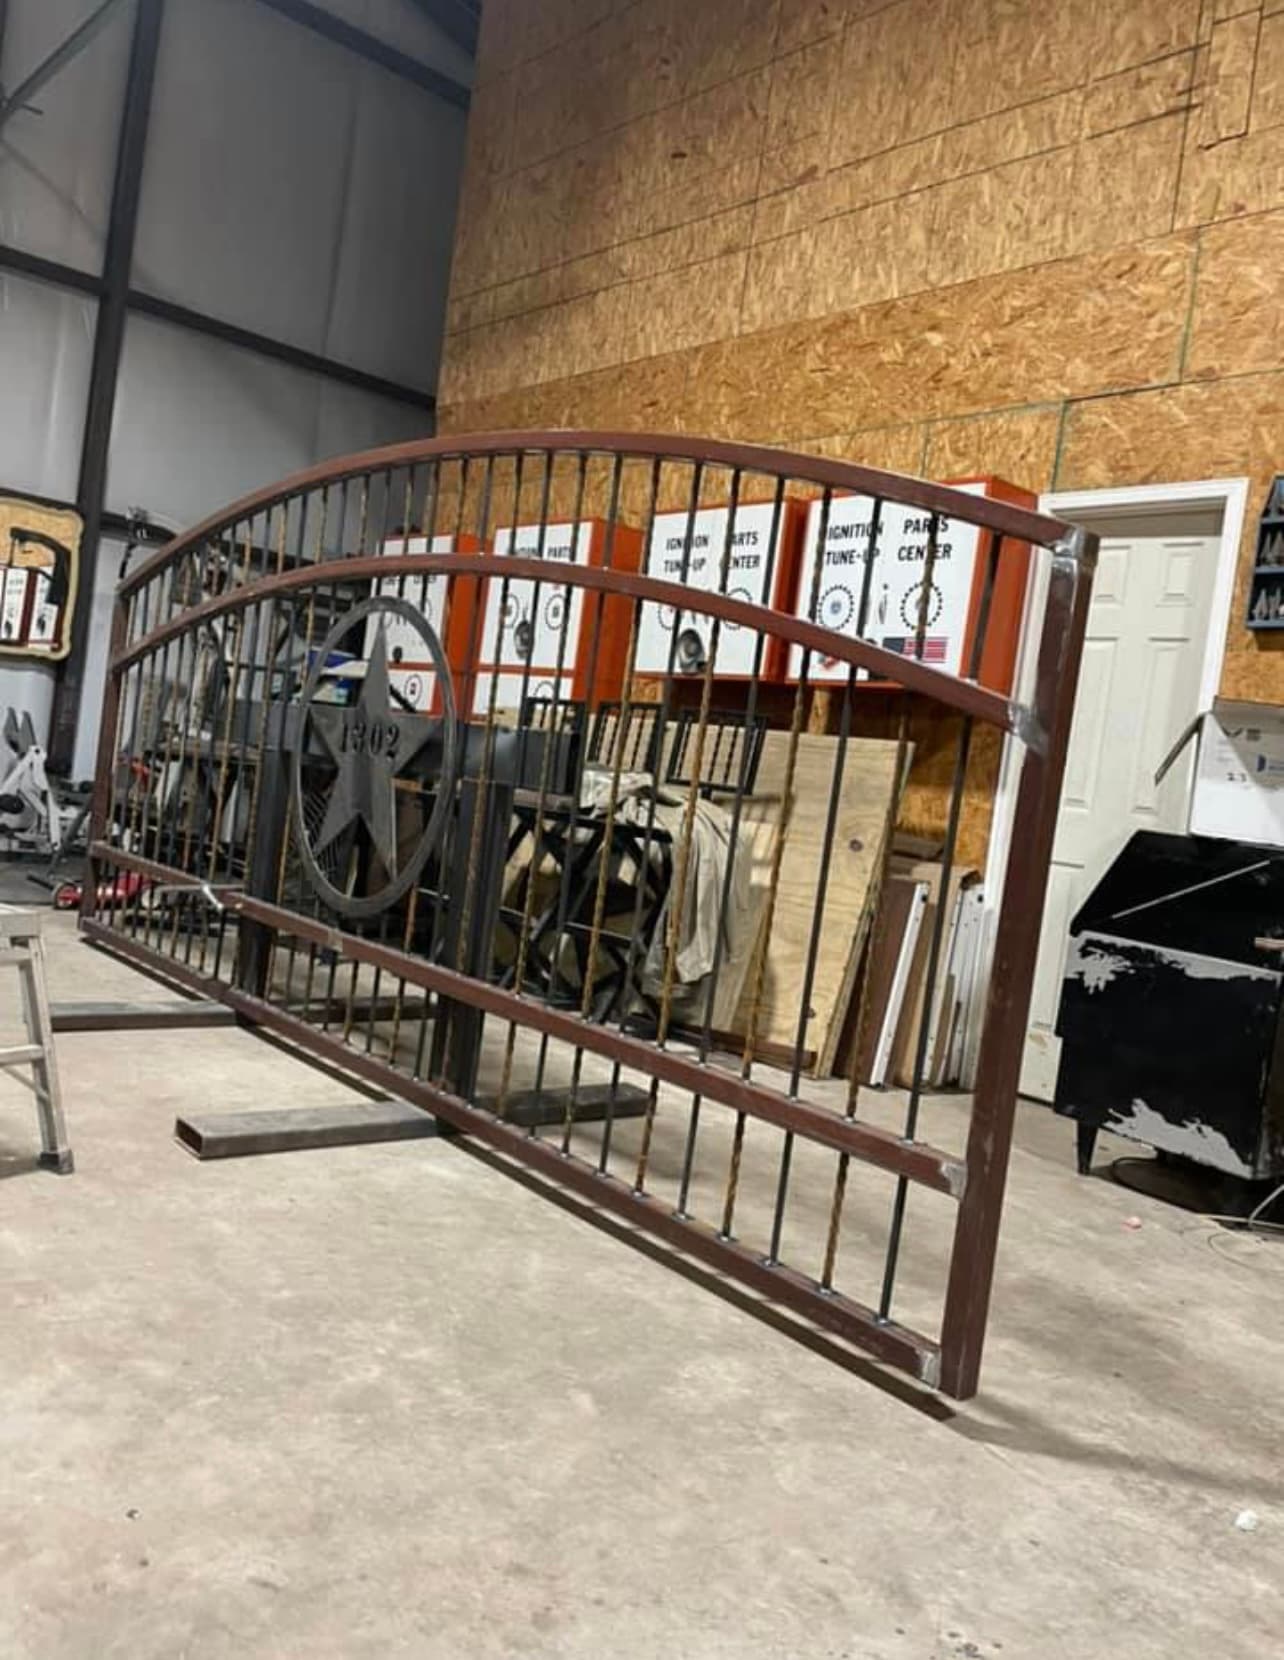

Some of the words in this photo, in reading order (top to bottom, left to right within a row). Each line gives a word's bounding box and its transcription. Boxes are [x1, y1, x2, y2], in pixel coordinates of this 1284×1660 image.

[903, 518, 950, 534] PARS
[666, 535, 710, 551] IGNION
[728, 532, 758, 547] ARTS
[898, 543, 953, 562] CENER
[664, 557, 707, 573] TUN-UP
[339, 721, 400, 761] 1302
